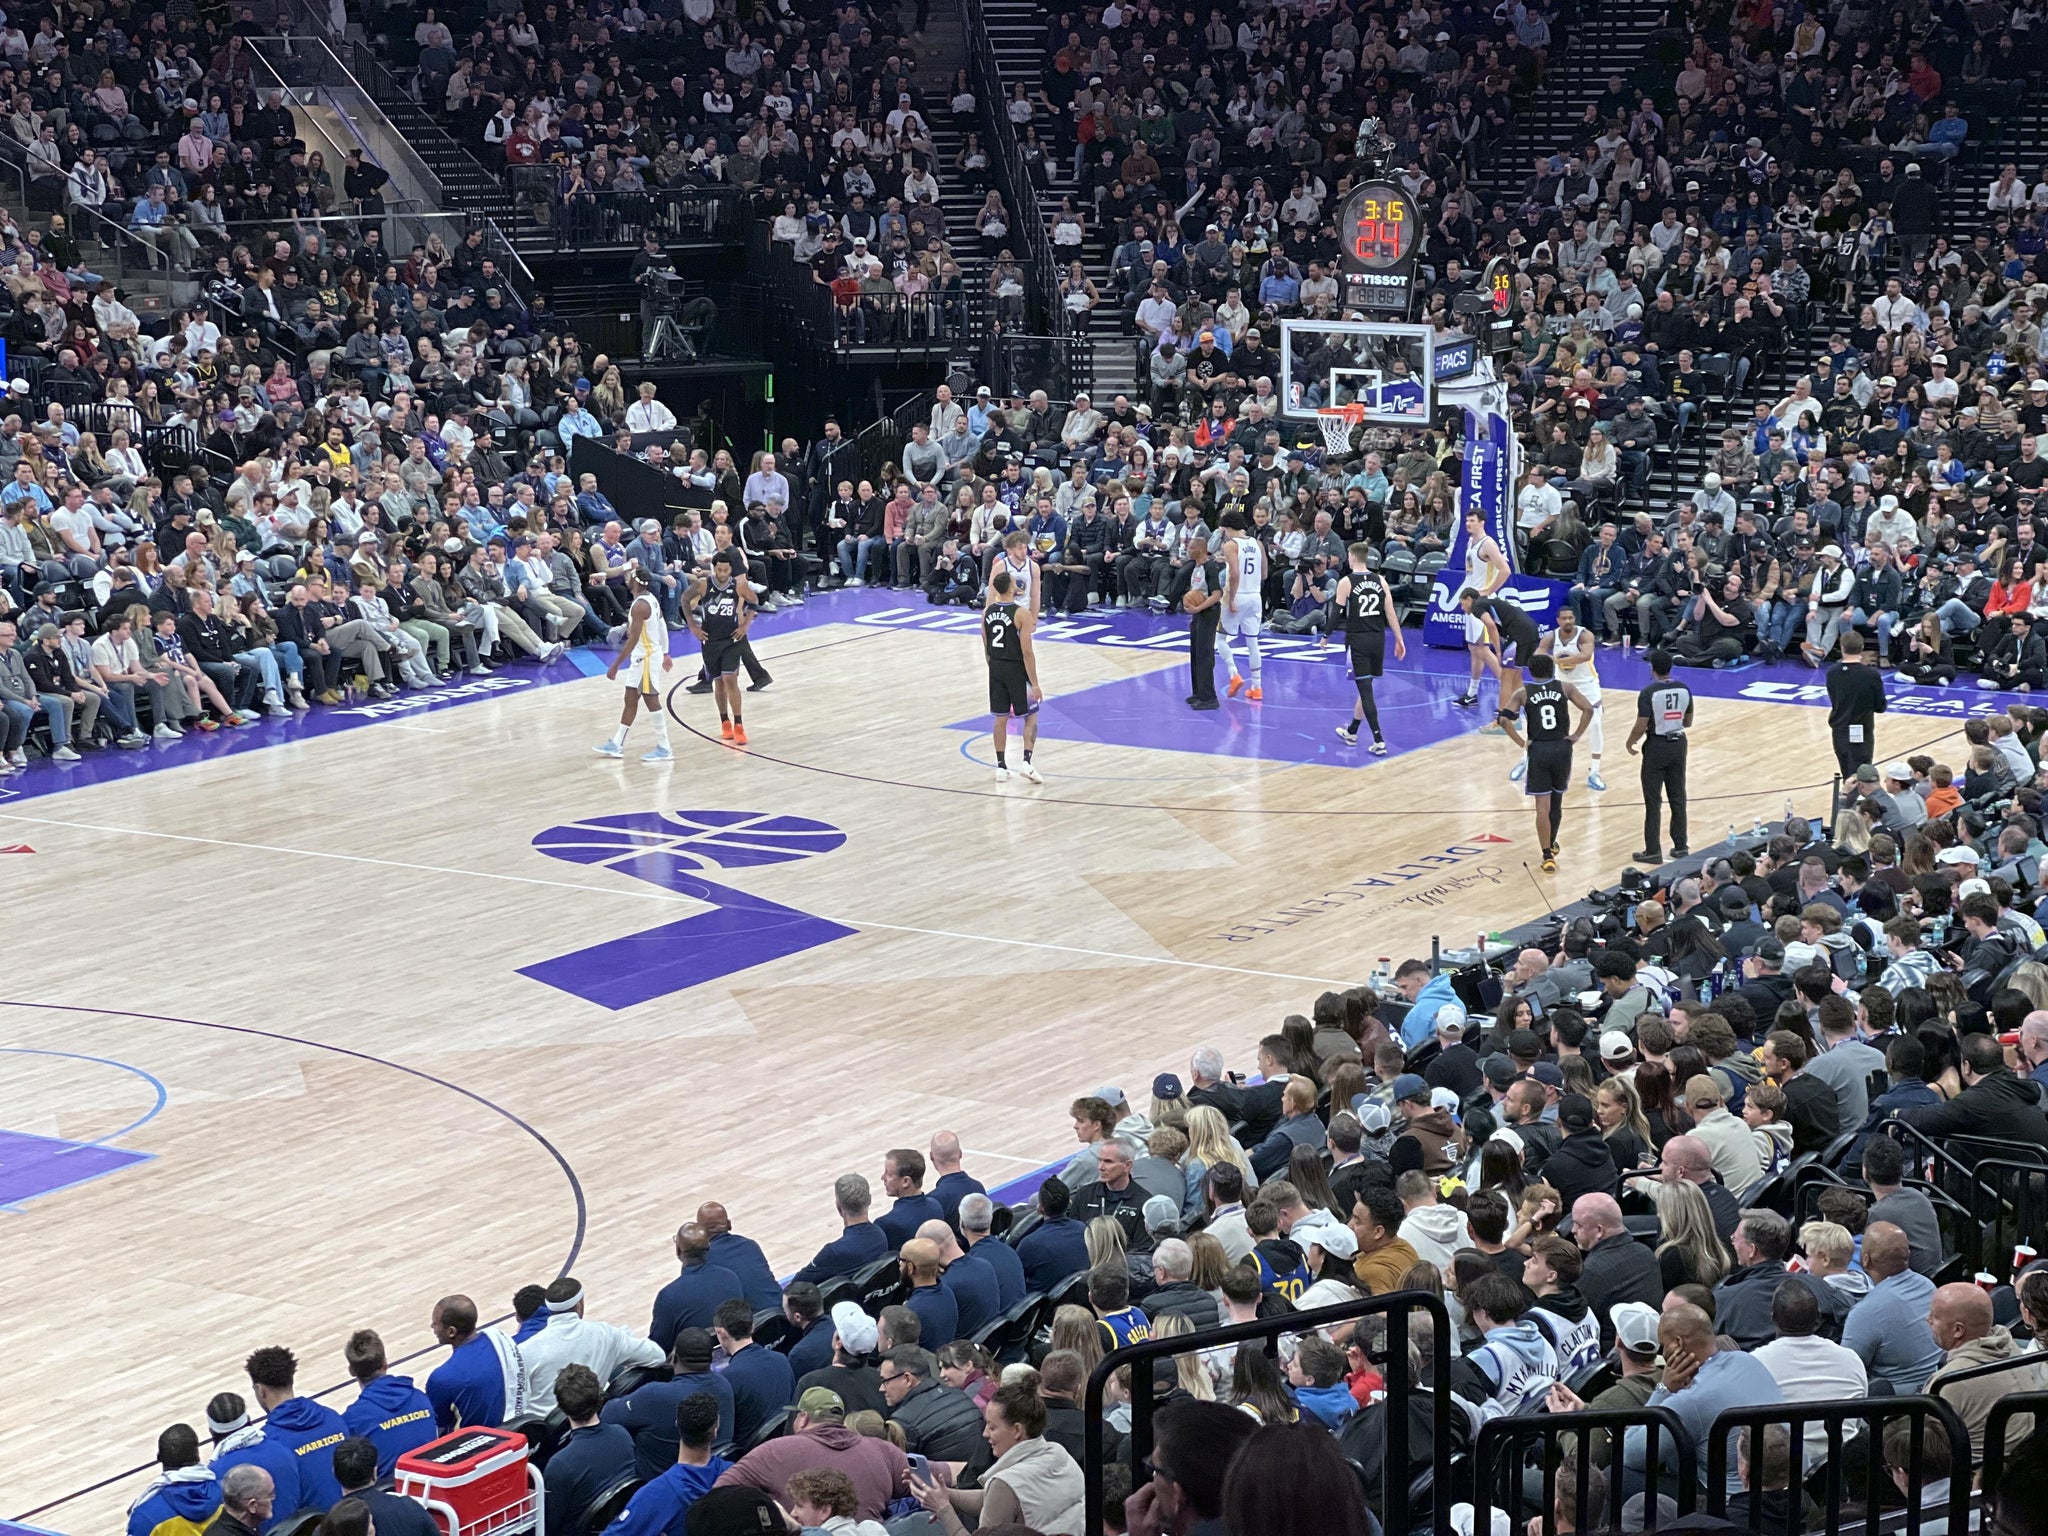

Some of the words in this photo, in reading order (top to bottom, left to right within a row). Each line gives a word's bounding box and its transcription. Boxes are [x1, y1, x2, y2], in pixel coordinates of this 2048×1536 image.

[1366, 200, 1403, 220] 3:15
[1356, 221, 1399, 258] 24
[1363, 274, 1408, 286] TISSOT
[1441, 350, 1467, 371] PACS
[1470, 443, 1485, 489] FIRST
[1495, 446, 1504, 491] FIRST
[1224, 502, 1245, 512] UTH
[1495, 493, 1510, 562] AMERICA
[1243, 557, 1255, 575] 15
[720, 604, 734, 616] 28
[1358, 593, 1380, 617] 22
[1430, 612, 1466, 624] AMERI
[991, 624, 1005, 648] 2
[330, 677, 532, 718] SEATGEEK
[1530, 690, 1562, 704] COLLIER
[1665, 693, 1679, 710] 27
[1540, 704, 1557, 730] 8
[1351, 846, 1487, 887] DELTA
[1207, 891, 1365, 943] CENTER
[1505, 1362, 1560, 1397] MYKHAILIU
[378, 1409, 431, 1431] WARRIORS
[294, 1432, 346, 1456] WARRIORS
